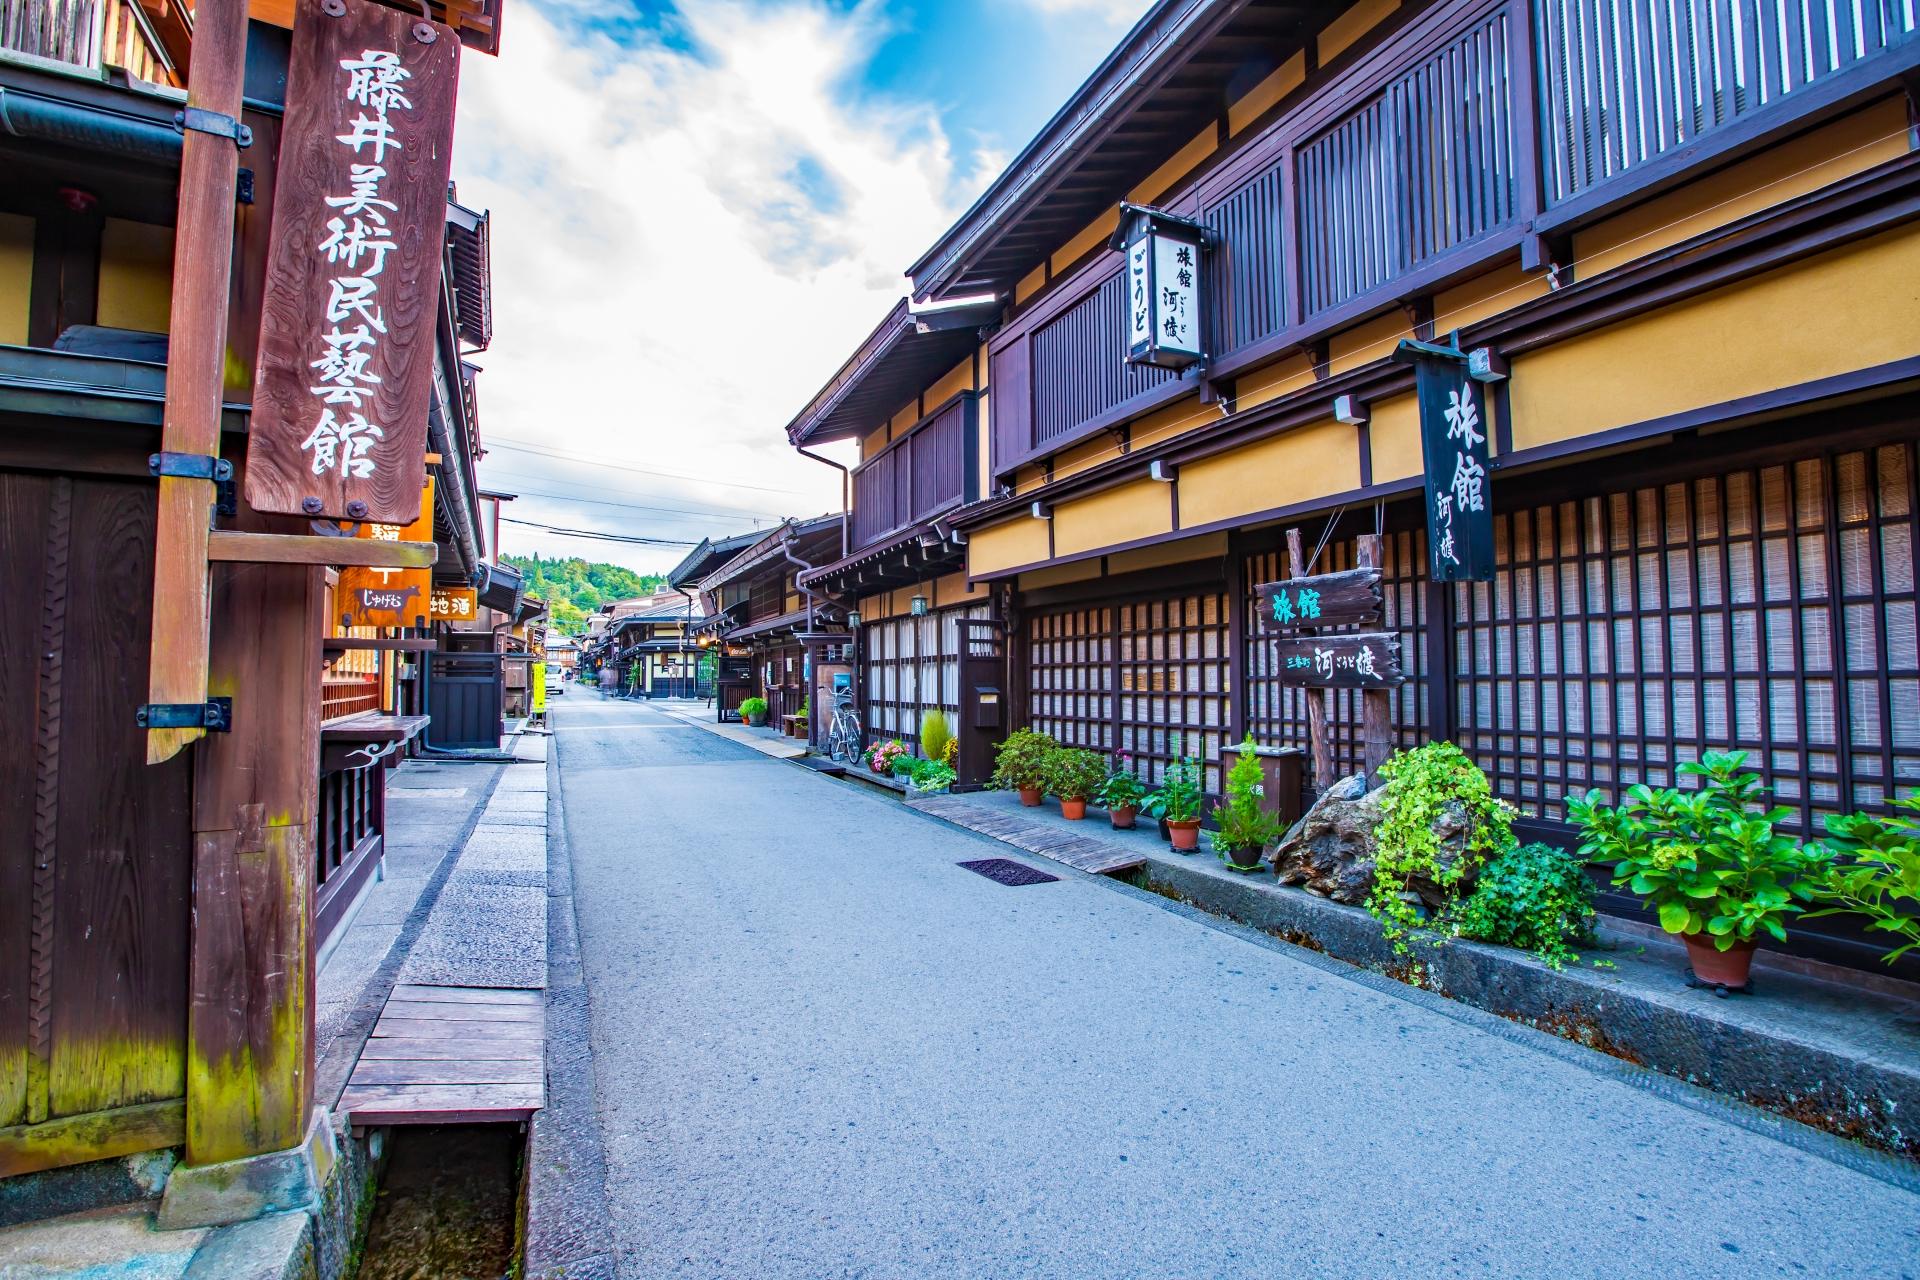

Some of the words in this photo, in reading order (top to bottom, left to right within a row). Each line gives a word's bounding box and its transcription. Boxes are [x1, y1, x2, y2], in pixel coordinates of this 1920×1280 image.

[301, 50, 412, 479] 藤井美術民藝館
[1133, 248, 1148, 332] ごうど
[1176, 246, 1194, 288] 旅館
[1443, 381, 1485, 514] 旅館
[364, 589, 402, 608] じゅげむ
[1272, 588, 1321, 625] 旅館
